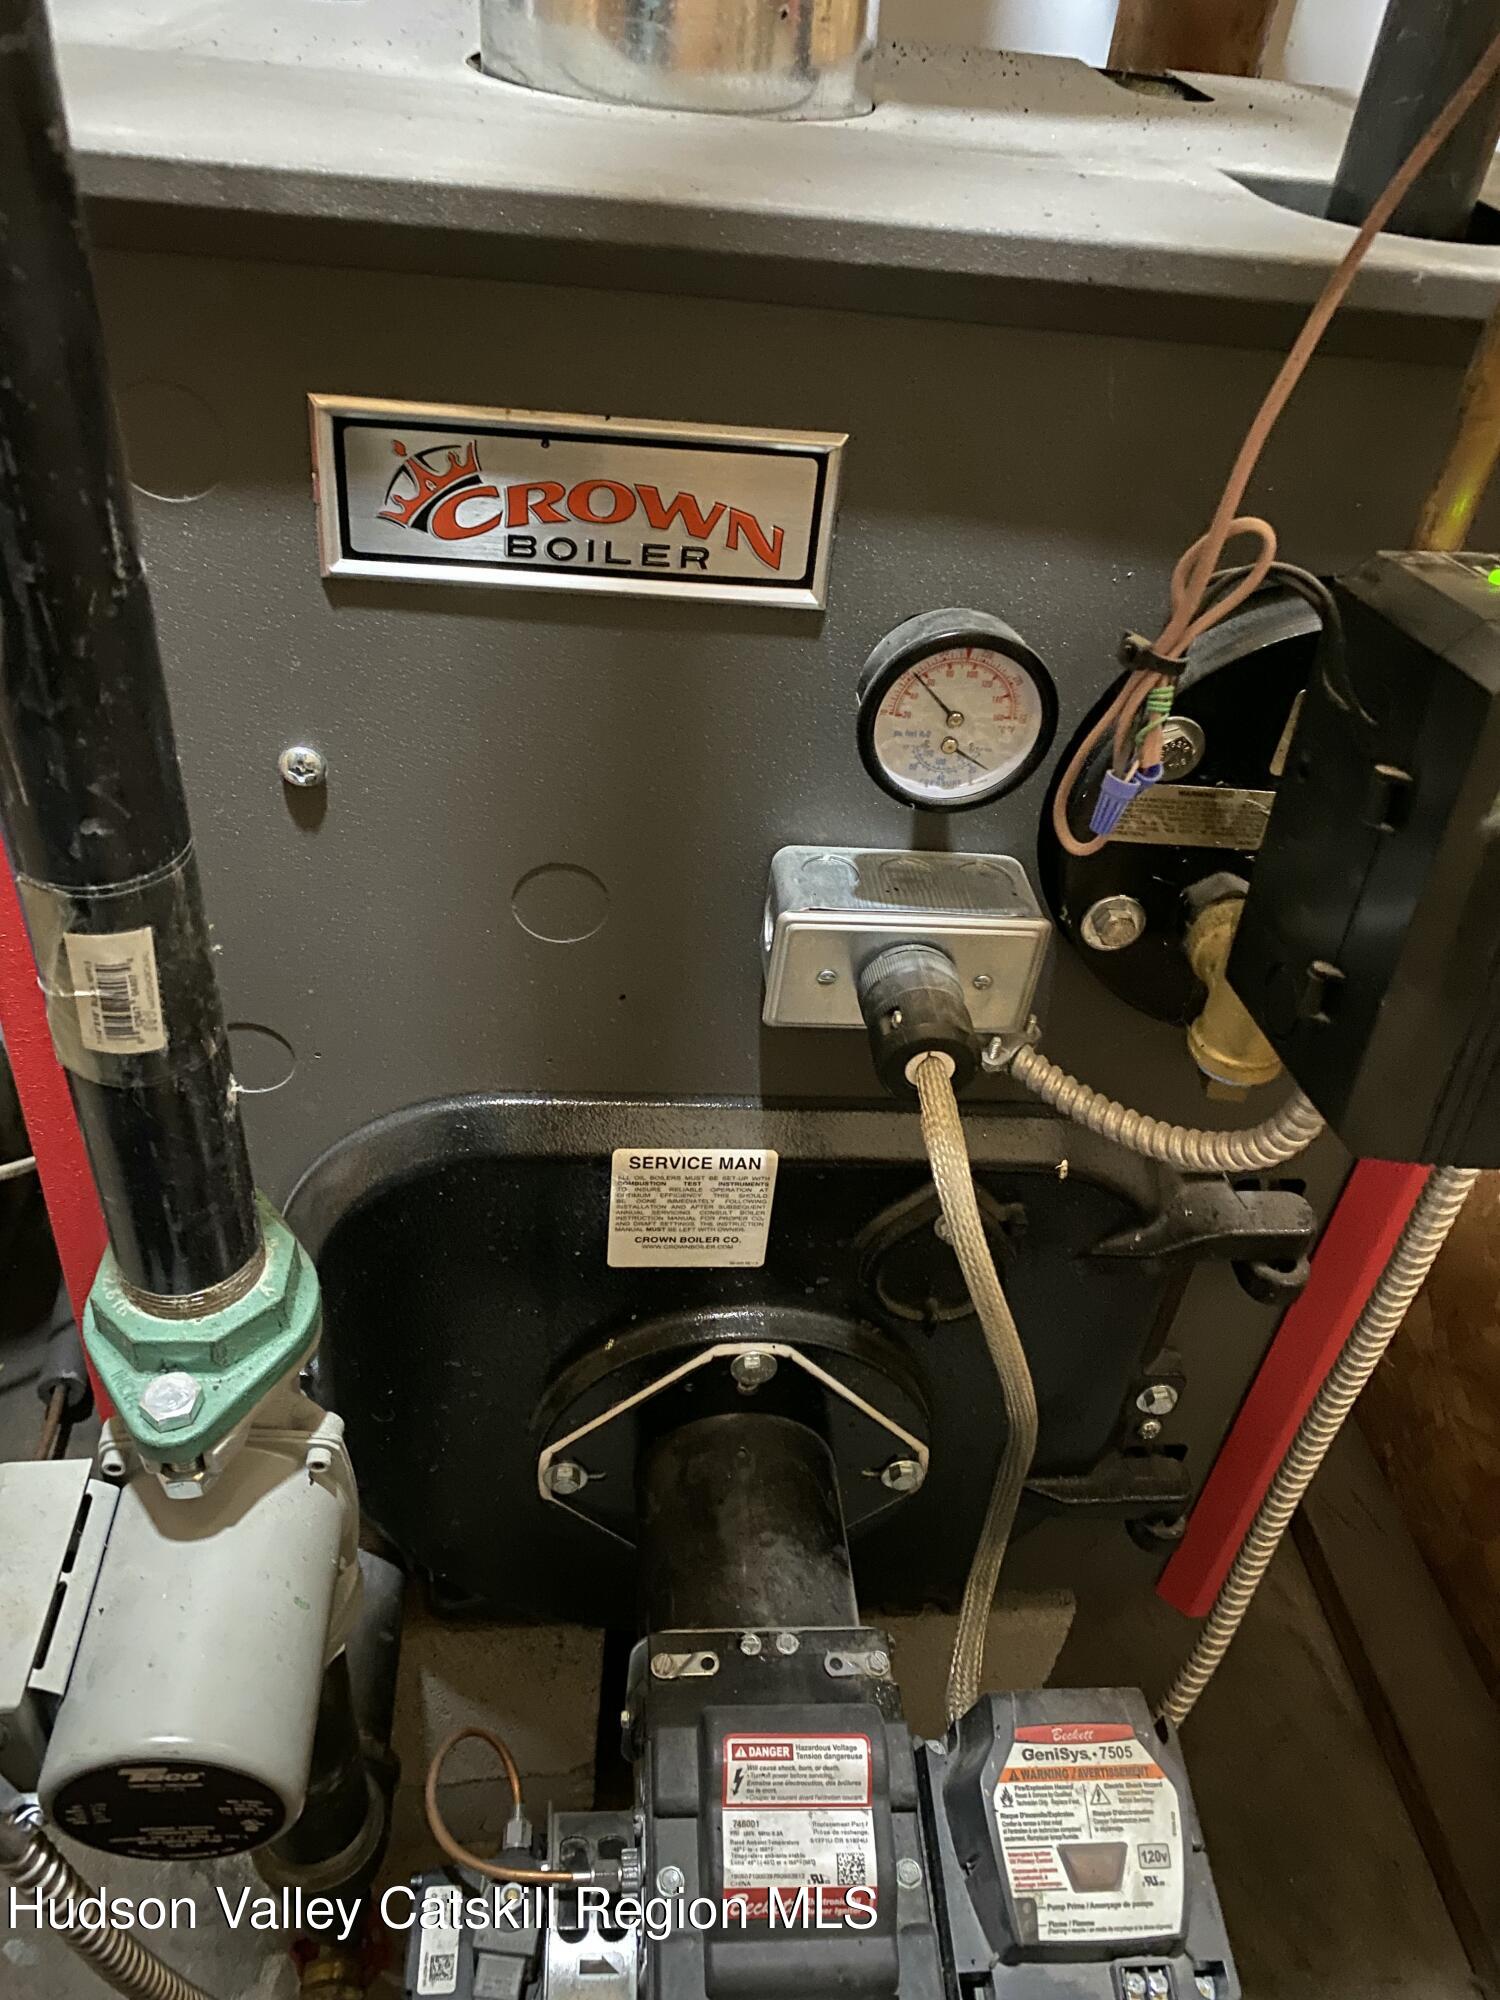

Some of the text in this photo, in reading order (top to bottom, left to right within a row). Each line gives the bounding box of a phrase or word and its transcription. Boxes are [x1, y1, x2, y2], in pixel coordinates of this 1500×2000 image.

[431, 479, 785, 571] CROWN
[506, 534, 710, 570] BOILER
[629, 1156, 761, 1170] SERVICE MAN
[1051, 1728, 1094, 1741] Beckett
[748, 1746, 790, 1757] DANGER
[795, 1744, 857, 1753] Hazardous Voltage
[1099, 1746, 1132, 1759] 7505
[796, 1752, 862, 1761] Tension dangereuse
[1022, 1768, 1068, 1780] WARNING
